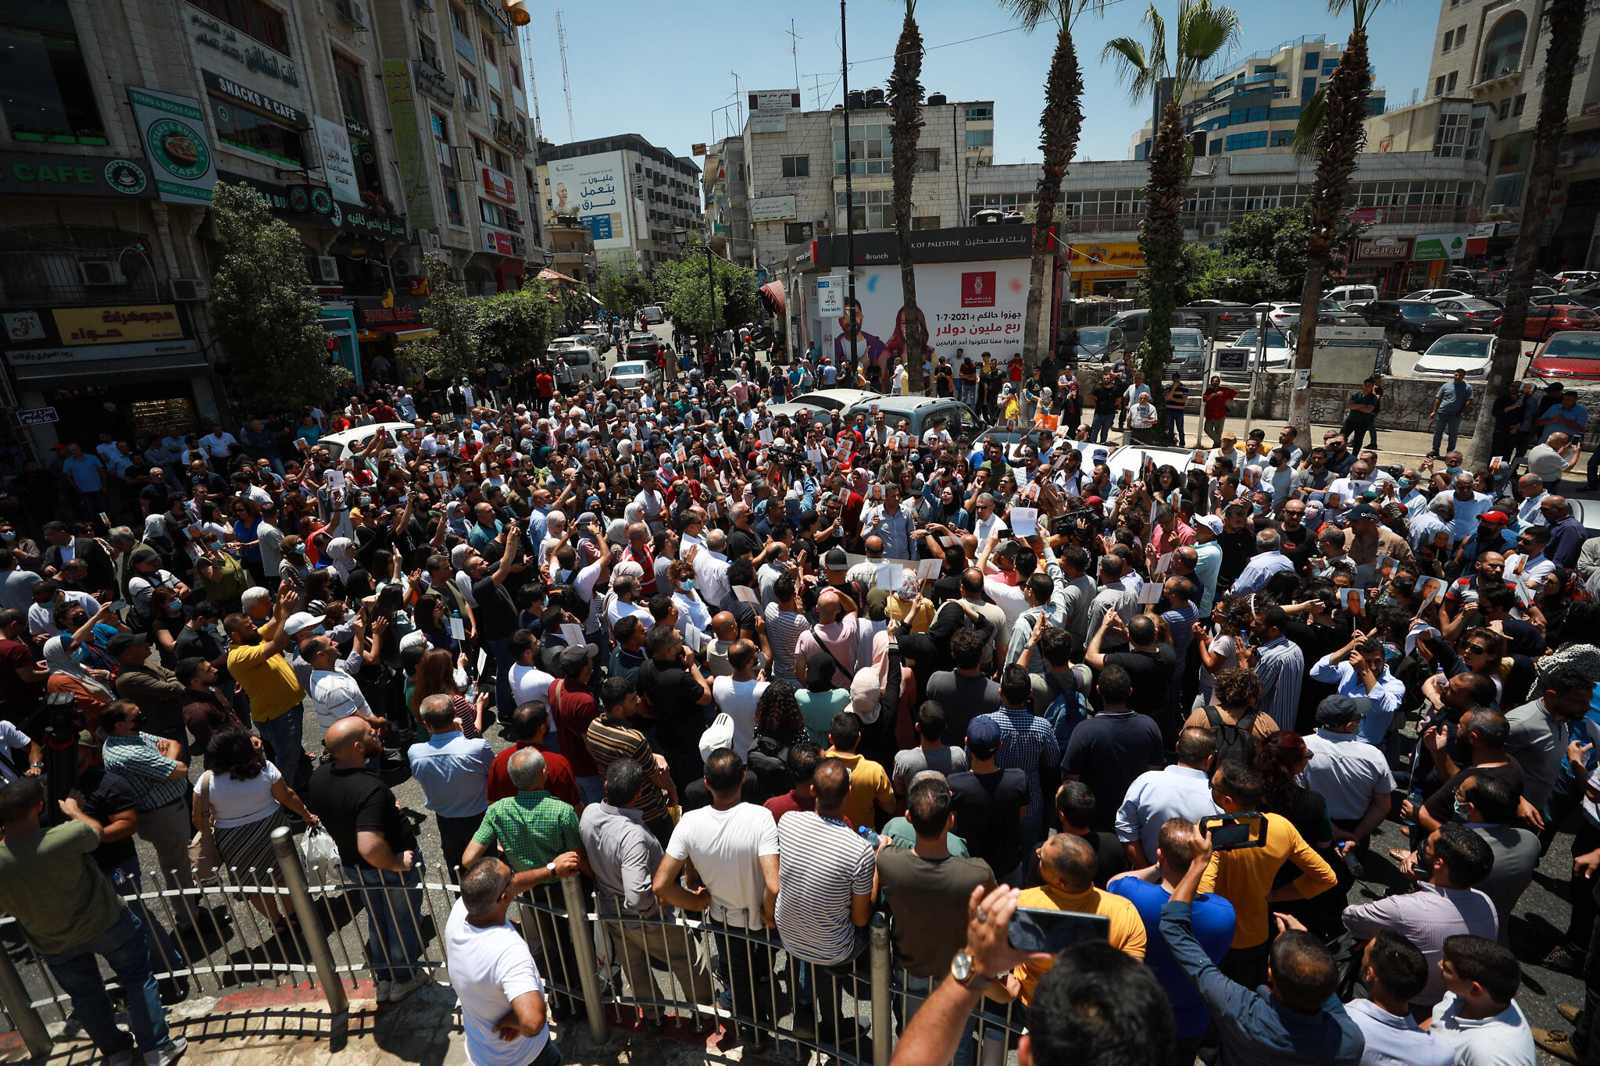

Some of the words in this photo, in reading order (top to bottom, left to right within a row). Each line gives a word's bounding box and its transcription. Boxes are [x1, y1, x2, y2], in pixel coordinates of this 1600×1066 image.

[218, 78, 262, 106] SNACKS
[263, 98, 272, 110] &
[272, 103, 297, 121] CAFE
[12, 161, 96, 184] CAFE
[928, 240, 960, 248] PALESTINE
[965, 237, 1004, 246] فلسطين
[936, 313, 970, 321] 1-7-2021
[936, 324, 966, 337] دولار
[969, 323, 1002, 336] مليون
[1004, 322, 1021, 334] ربع
